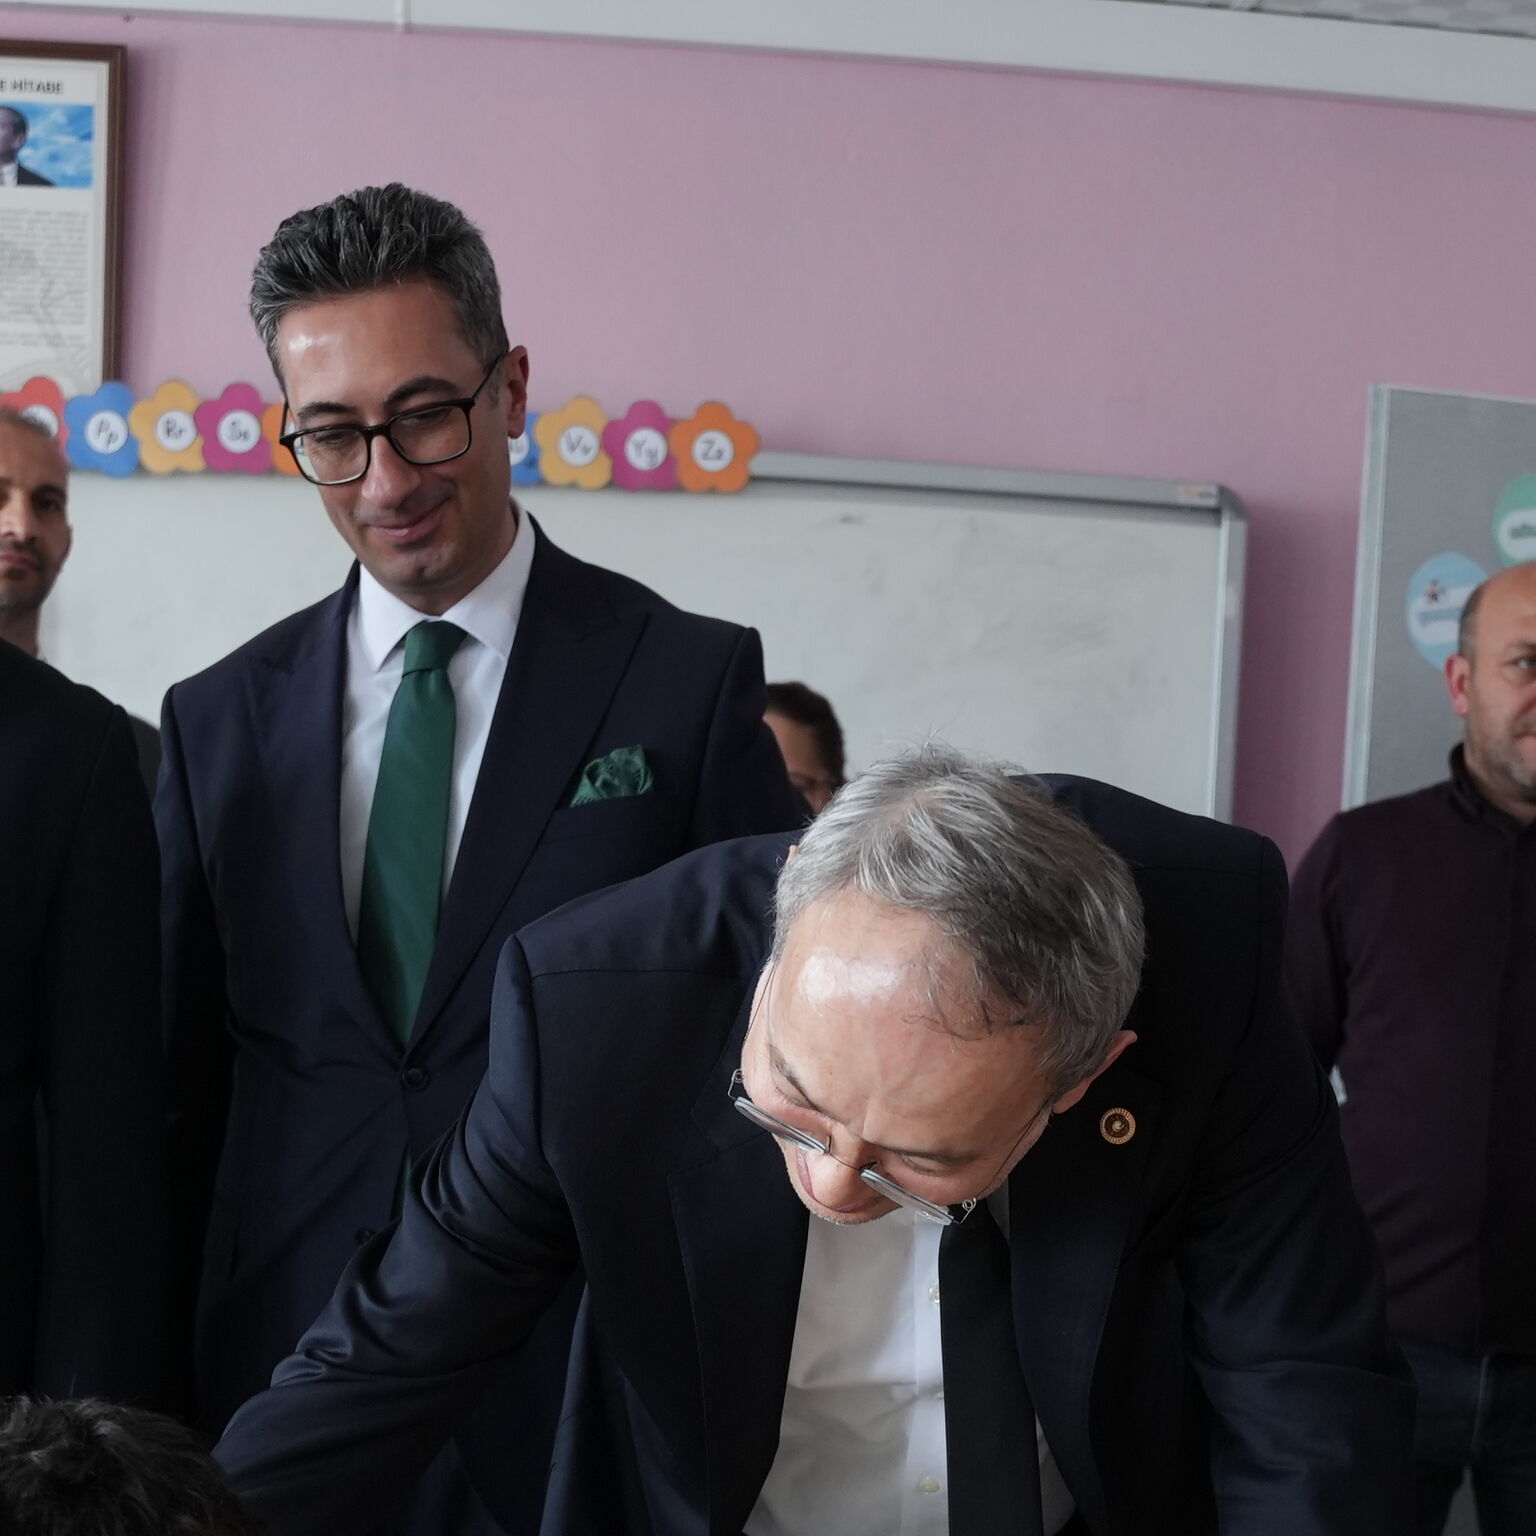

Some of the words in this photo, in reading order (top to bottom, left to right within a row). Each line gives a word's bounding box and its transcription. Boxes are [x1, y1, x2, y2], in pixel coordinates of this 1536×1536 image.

[96, 418, 120, 449] Pp
[164, 418, 187, 440] Rr
[566, 431, 592, 455] Vv
[630, 437, 660, 468] Yy
[701, 440, 725, 461] Zz
